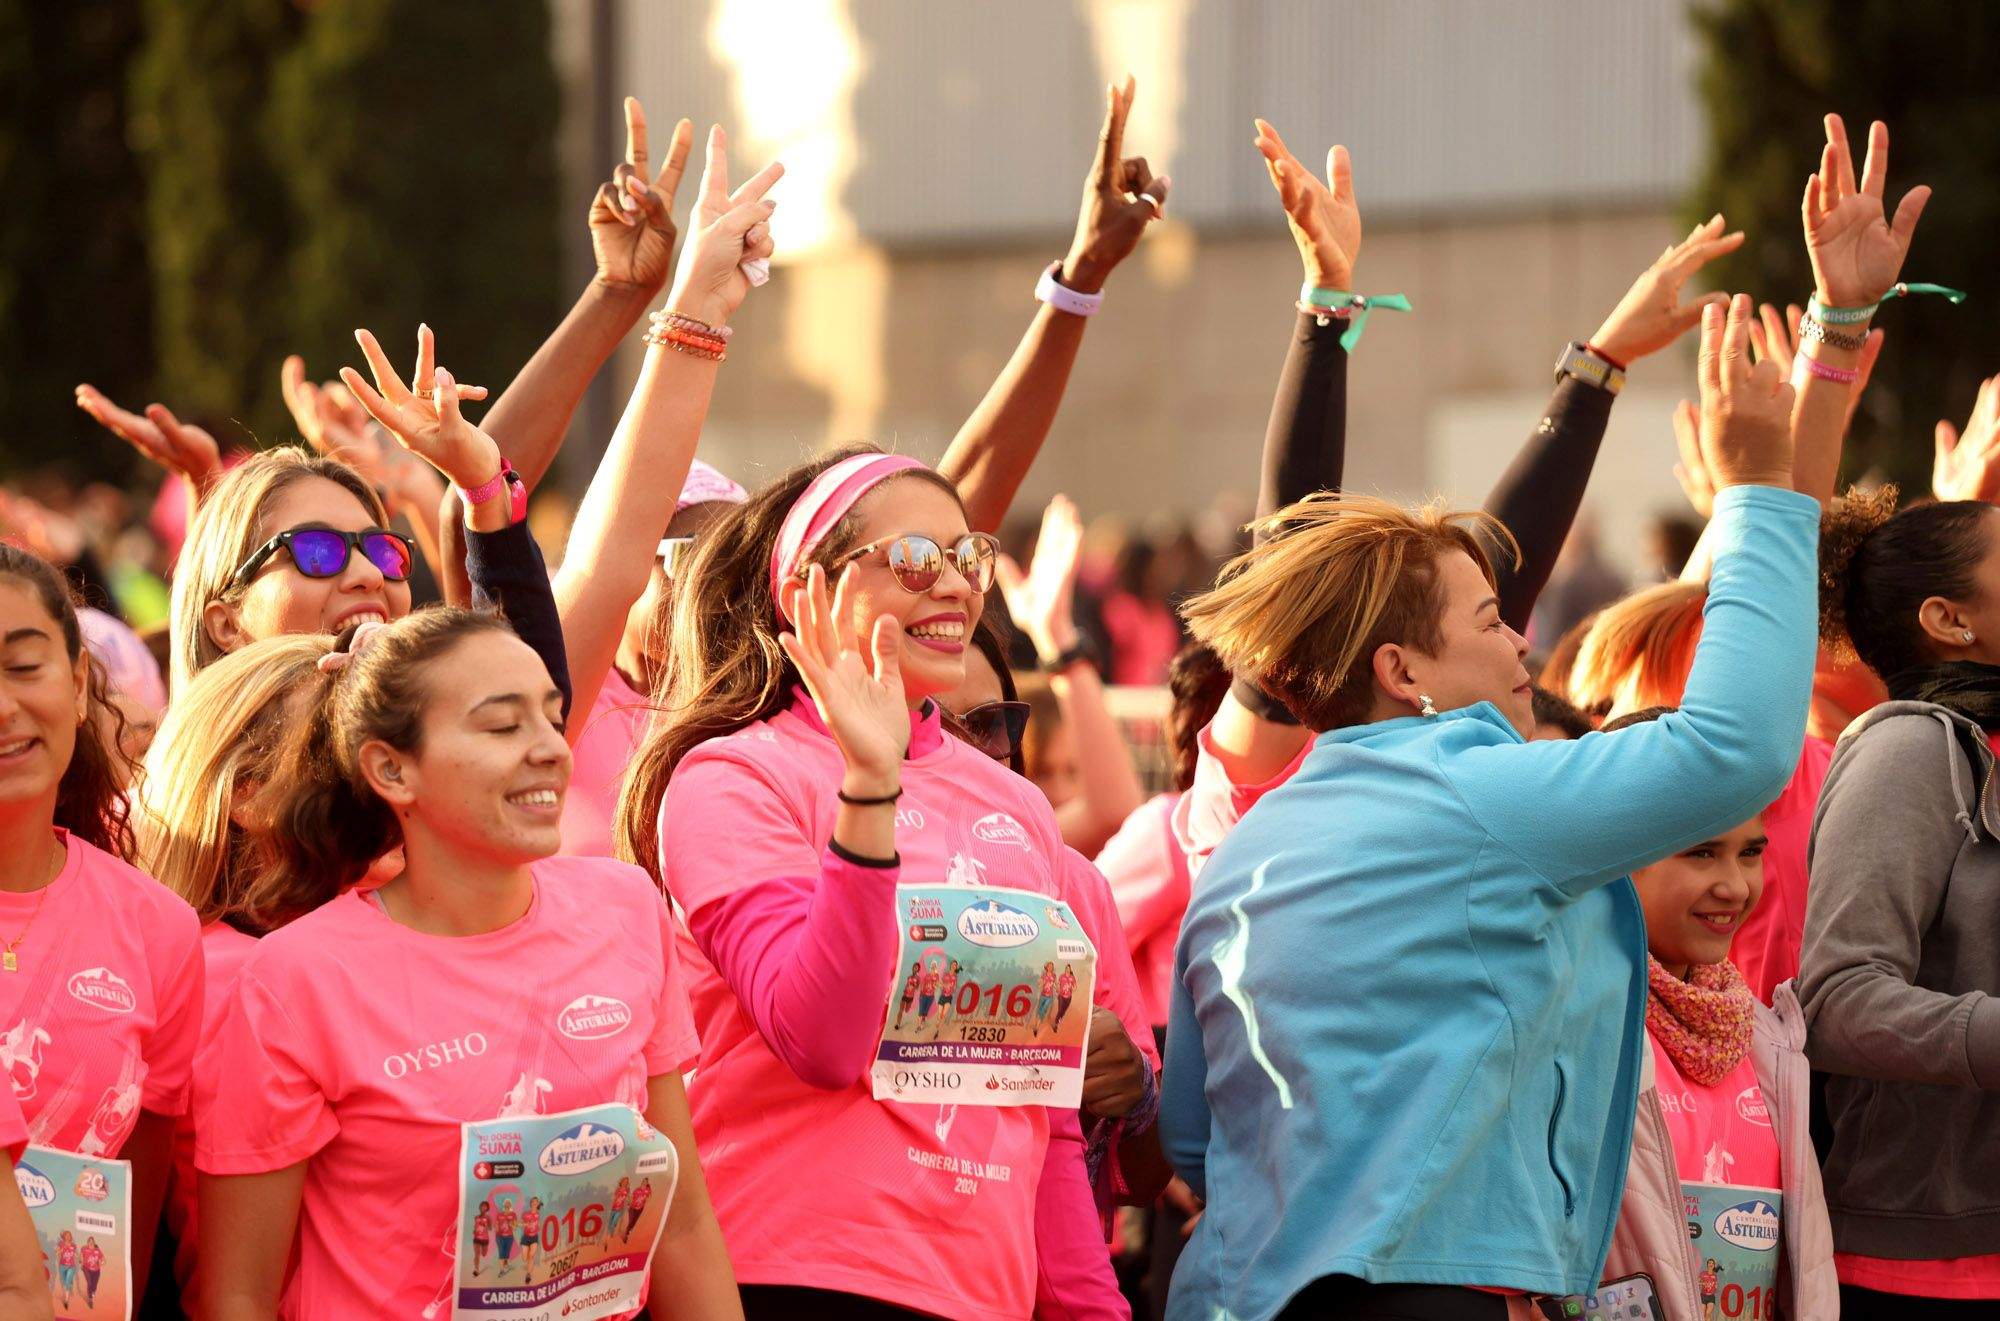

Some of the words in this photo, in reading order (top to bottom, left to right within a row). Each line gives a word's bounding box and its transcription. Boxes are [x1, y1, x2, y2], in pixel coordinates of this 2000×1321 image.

[894, 809, 924, 829] HO
[910, 907, 944, 919] SUMA
[964, 915, 1035, 936] ASTURIANA
[955, 982, 1034, 1018] 016
[960, 1026, 1006, 1043] 12830
[383, 1032, 488, 1080] OYSHO
[899, 1046, 938, 1058] CARRERA
[941, 1046, 953, 1058] DE
[956, 1047, 968, 1059] LA
[971, 1047, 1002, 1060] MUJER
[1011, 1049, 1062, 1062] BARCELONA
[894, 1071, 961, 1089] OYSHO
[1001, 1077, 1056, 1091] Santander
[1659, 1092, 1696, 1113] SHO
[479, 1142, 522, 1156] SUMA
[546, 1143, 618, 1167] ASTURIANA
[907, 1146, 958, 1173] CARRERA
[961, 1158, 973, 1175] DE
[973, 1162, 984, 1178] LA
[953, 1177, 979, 1196] 2024
[541, 1203, 605, 1252] 016
[549, 1250, 579, 1278] 20627
[482, 1291, 535, 1304] CARRERA
[537, 1286, 548, 1300] DE
[548, 1283, 557, 1296] LA
[582, 1257, 629, 1281] BARCELONA
[571, 1287, 621, 1313] Santander
